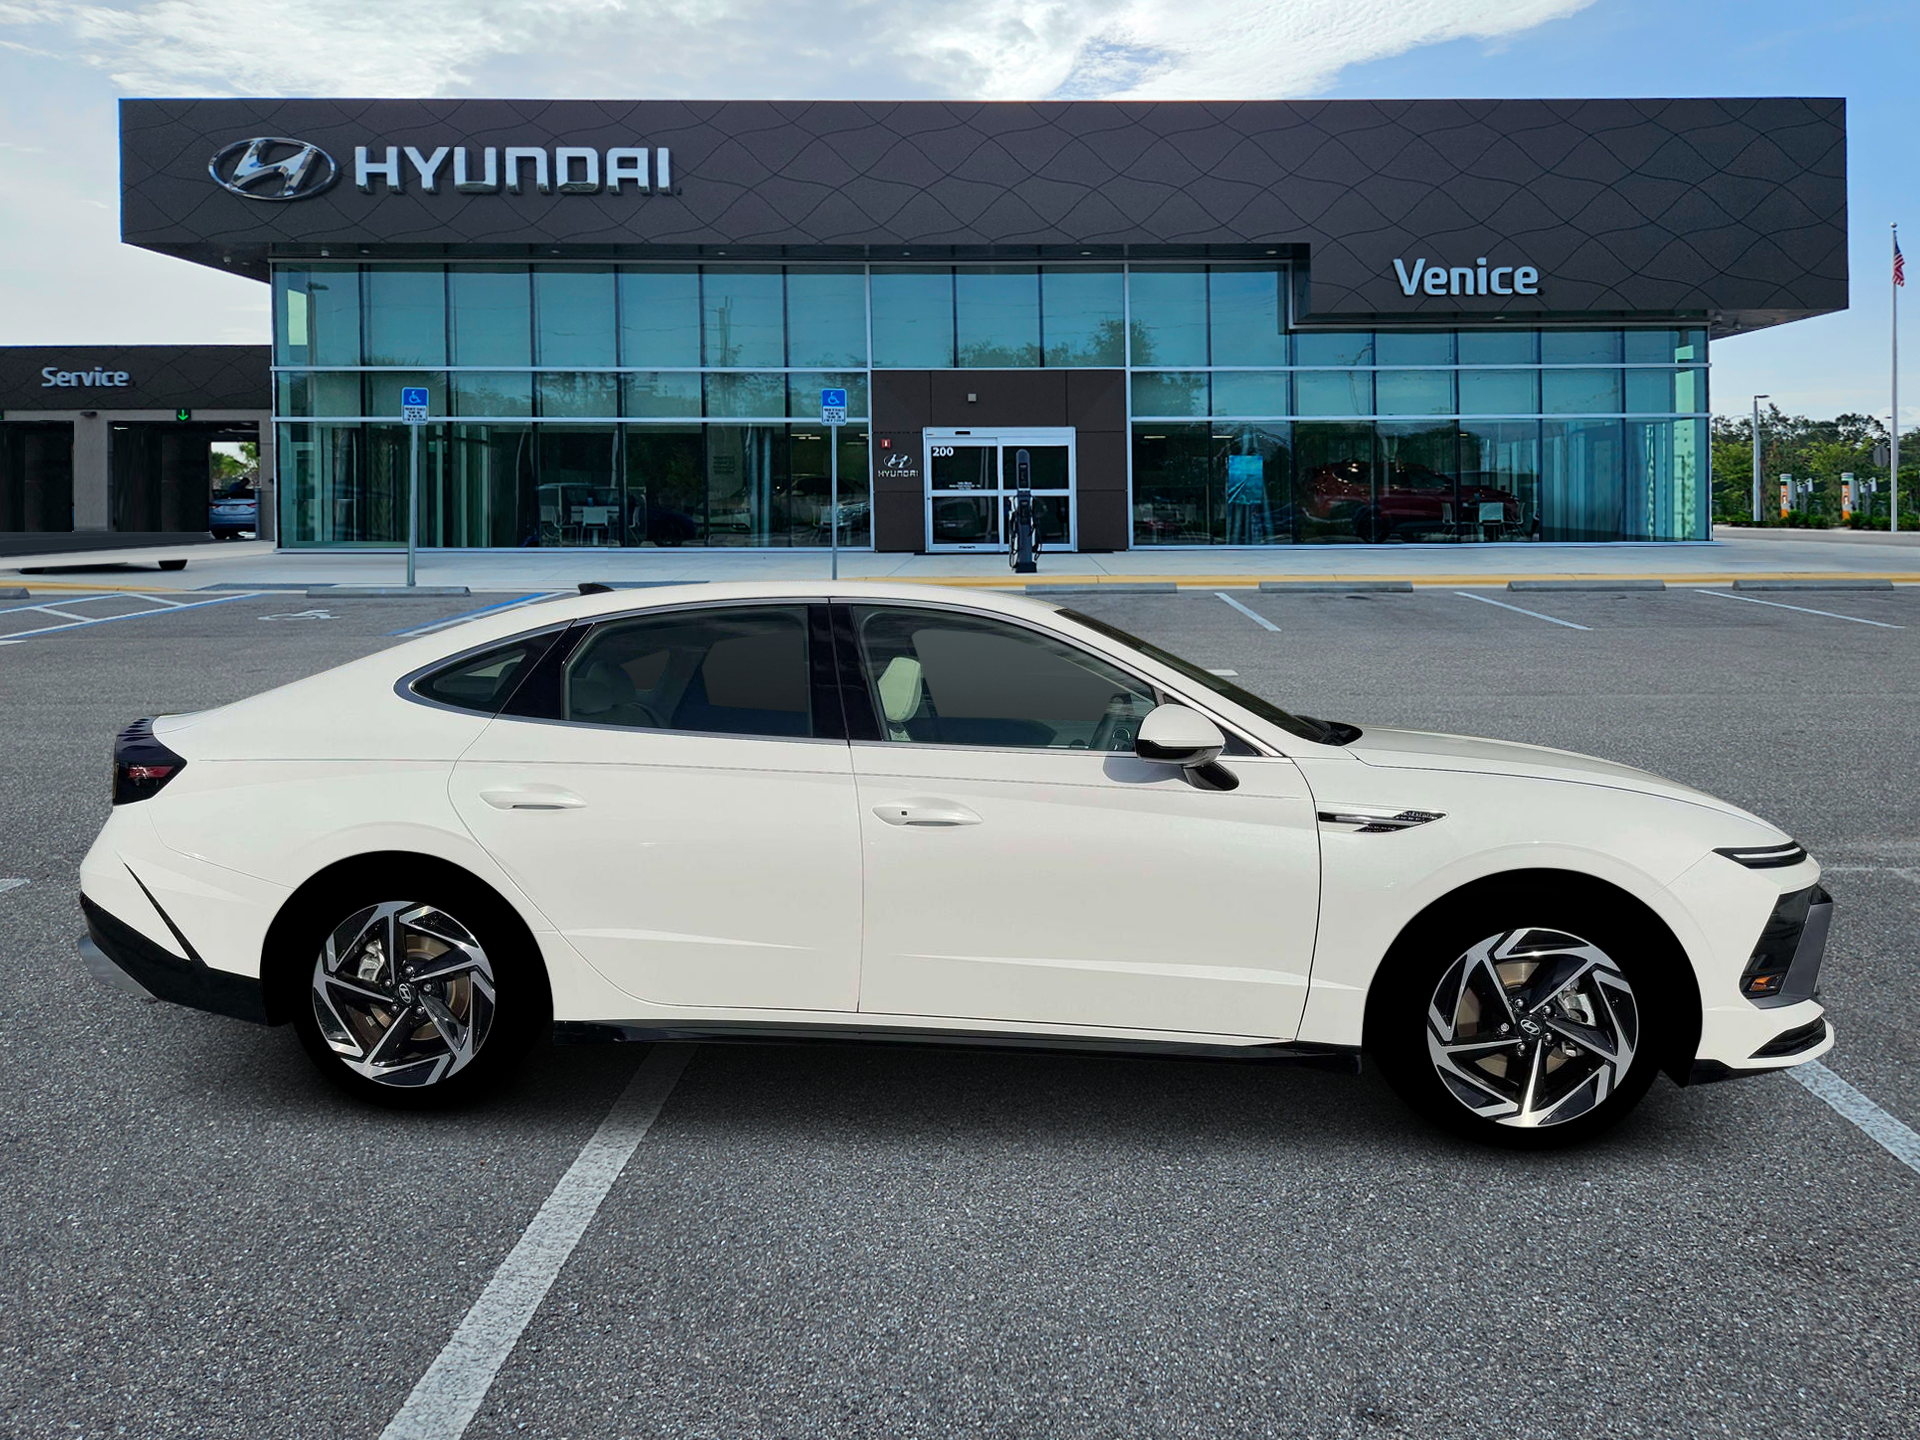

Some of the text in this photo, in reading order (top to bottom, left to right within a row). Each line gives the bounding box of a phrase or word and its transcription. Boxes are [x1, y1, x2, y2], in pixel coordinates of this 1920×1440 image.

[354, 146, 674, 195] HYUNDAI
[1393, 257, 1539, 296] Venice
[41, 366, 130, 387] Service
[932, 446, 954, 457] 200
